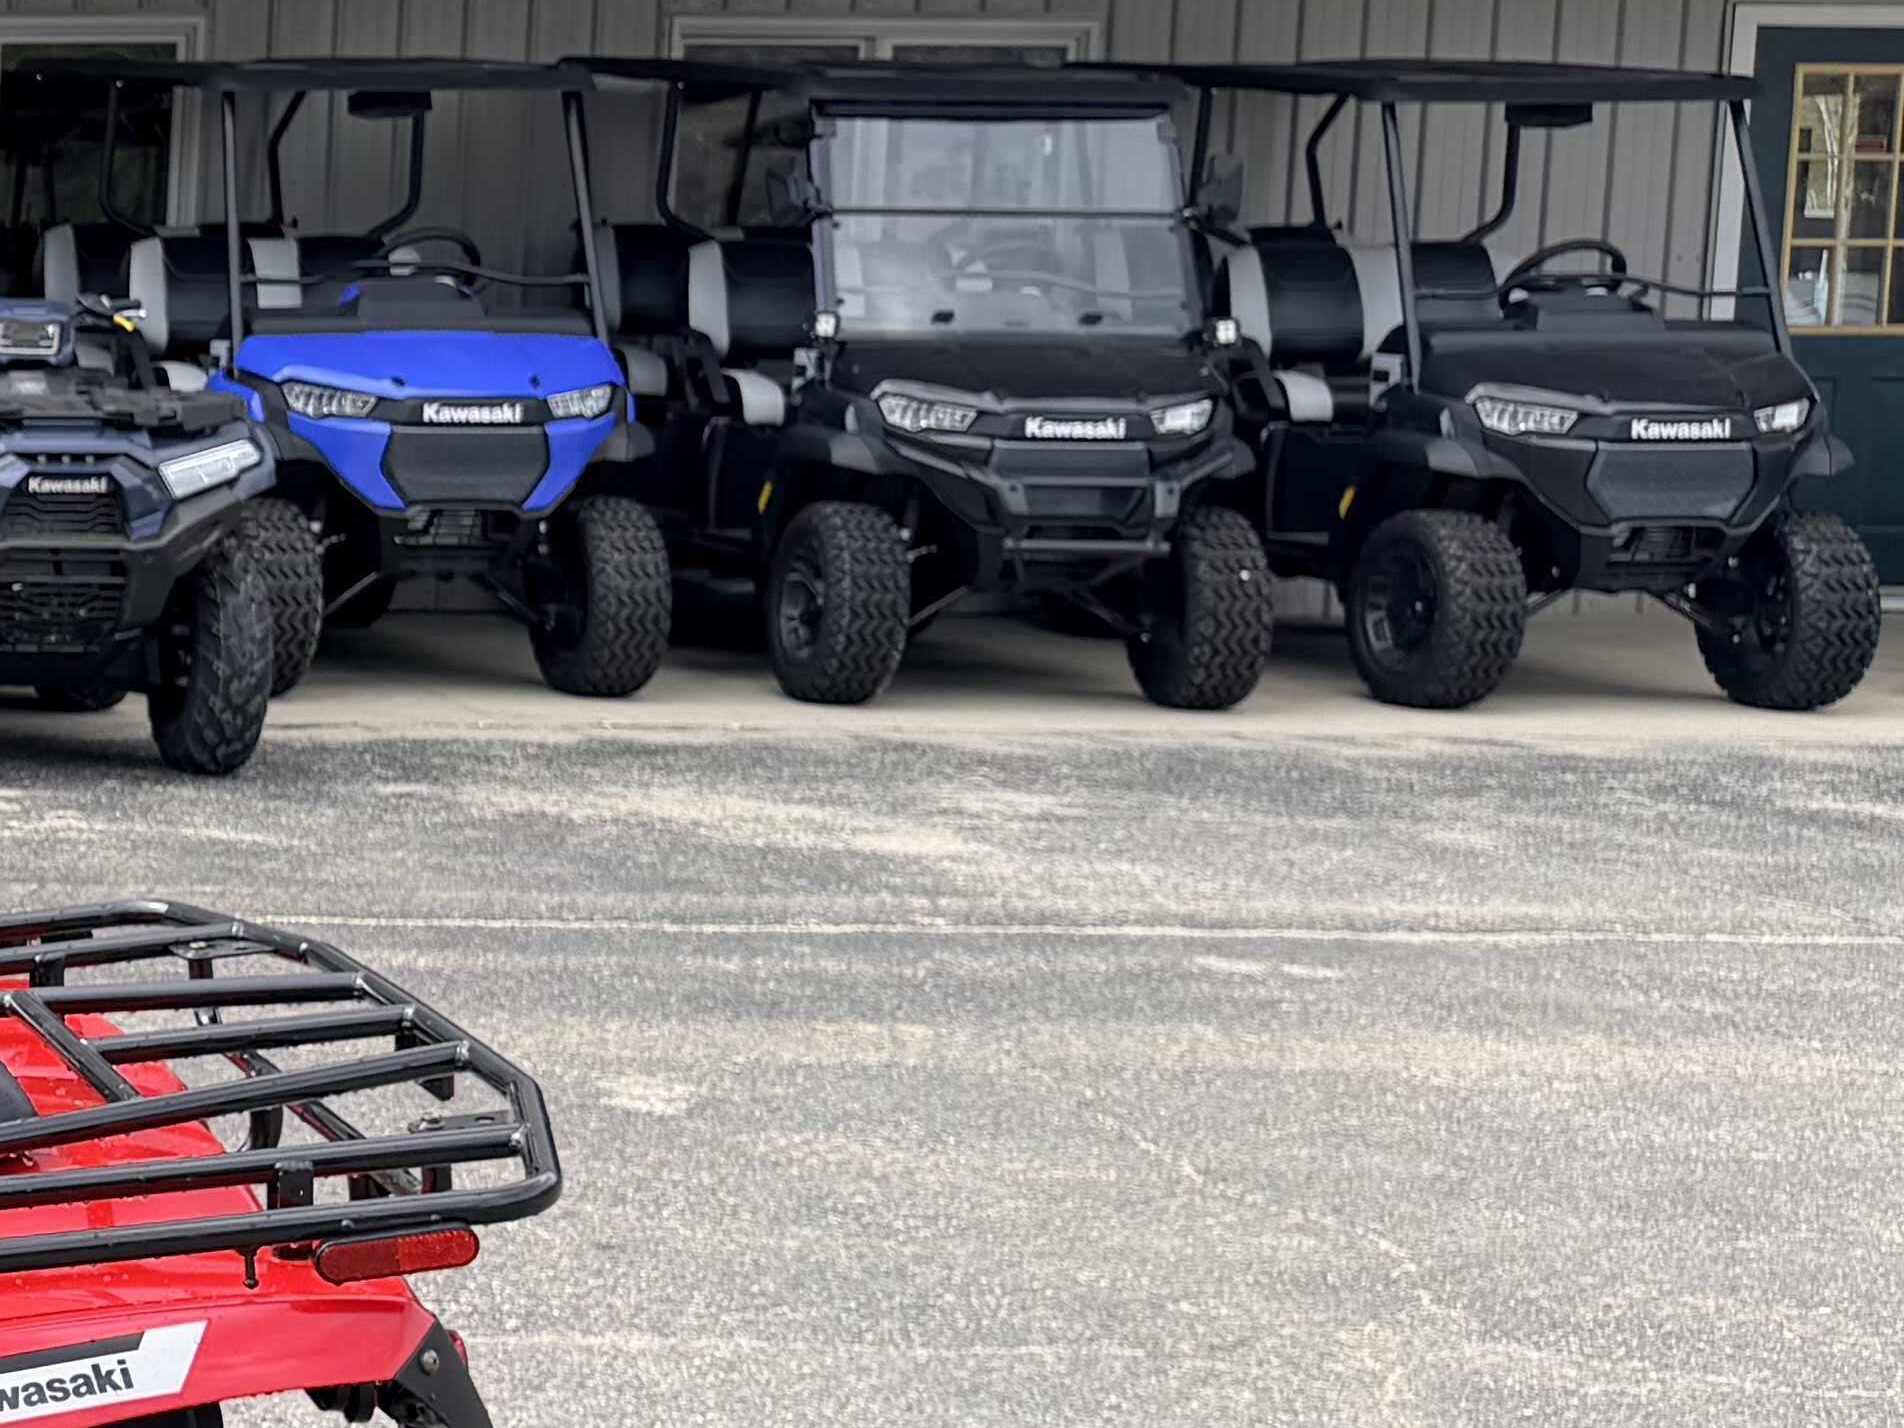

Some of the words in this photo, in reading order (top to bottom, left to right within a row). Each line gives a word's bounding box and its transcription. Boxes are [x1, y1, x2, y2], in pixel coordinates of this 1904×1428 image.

[421, 401, 523, 425] Kawasaki
[1024, 416, 1126, 440] Kawasaki
[1630, 417, 1731, 440] Kawasaki
[28, 475, 109, 494] Kawasaki
